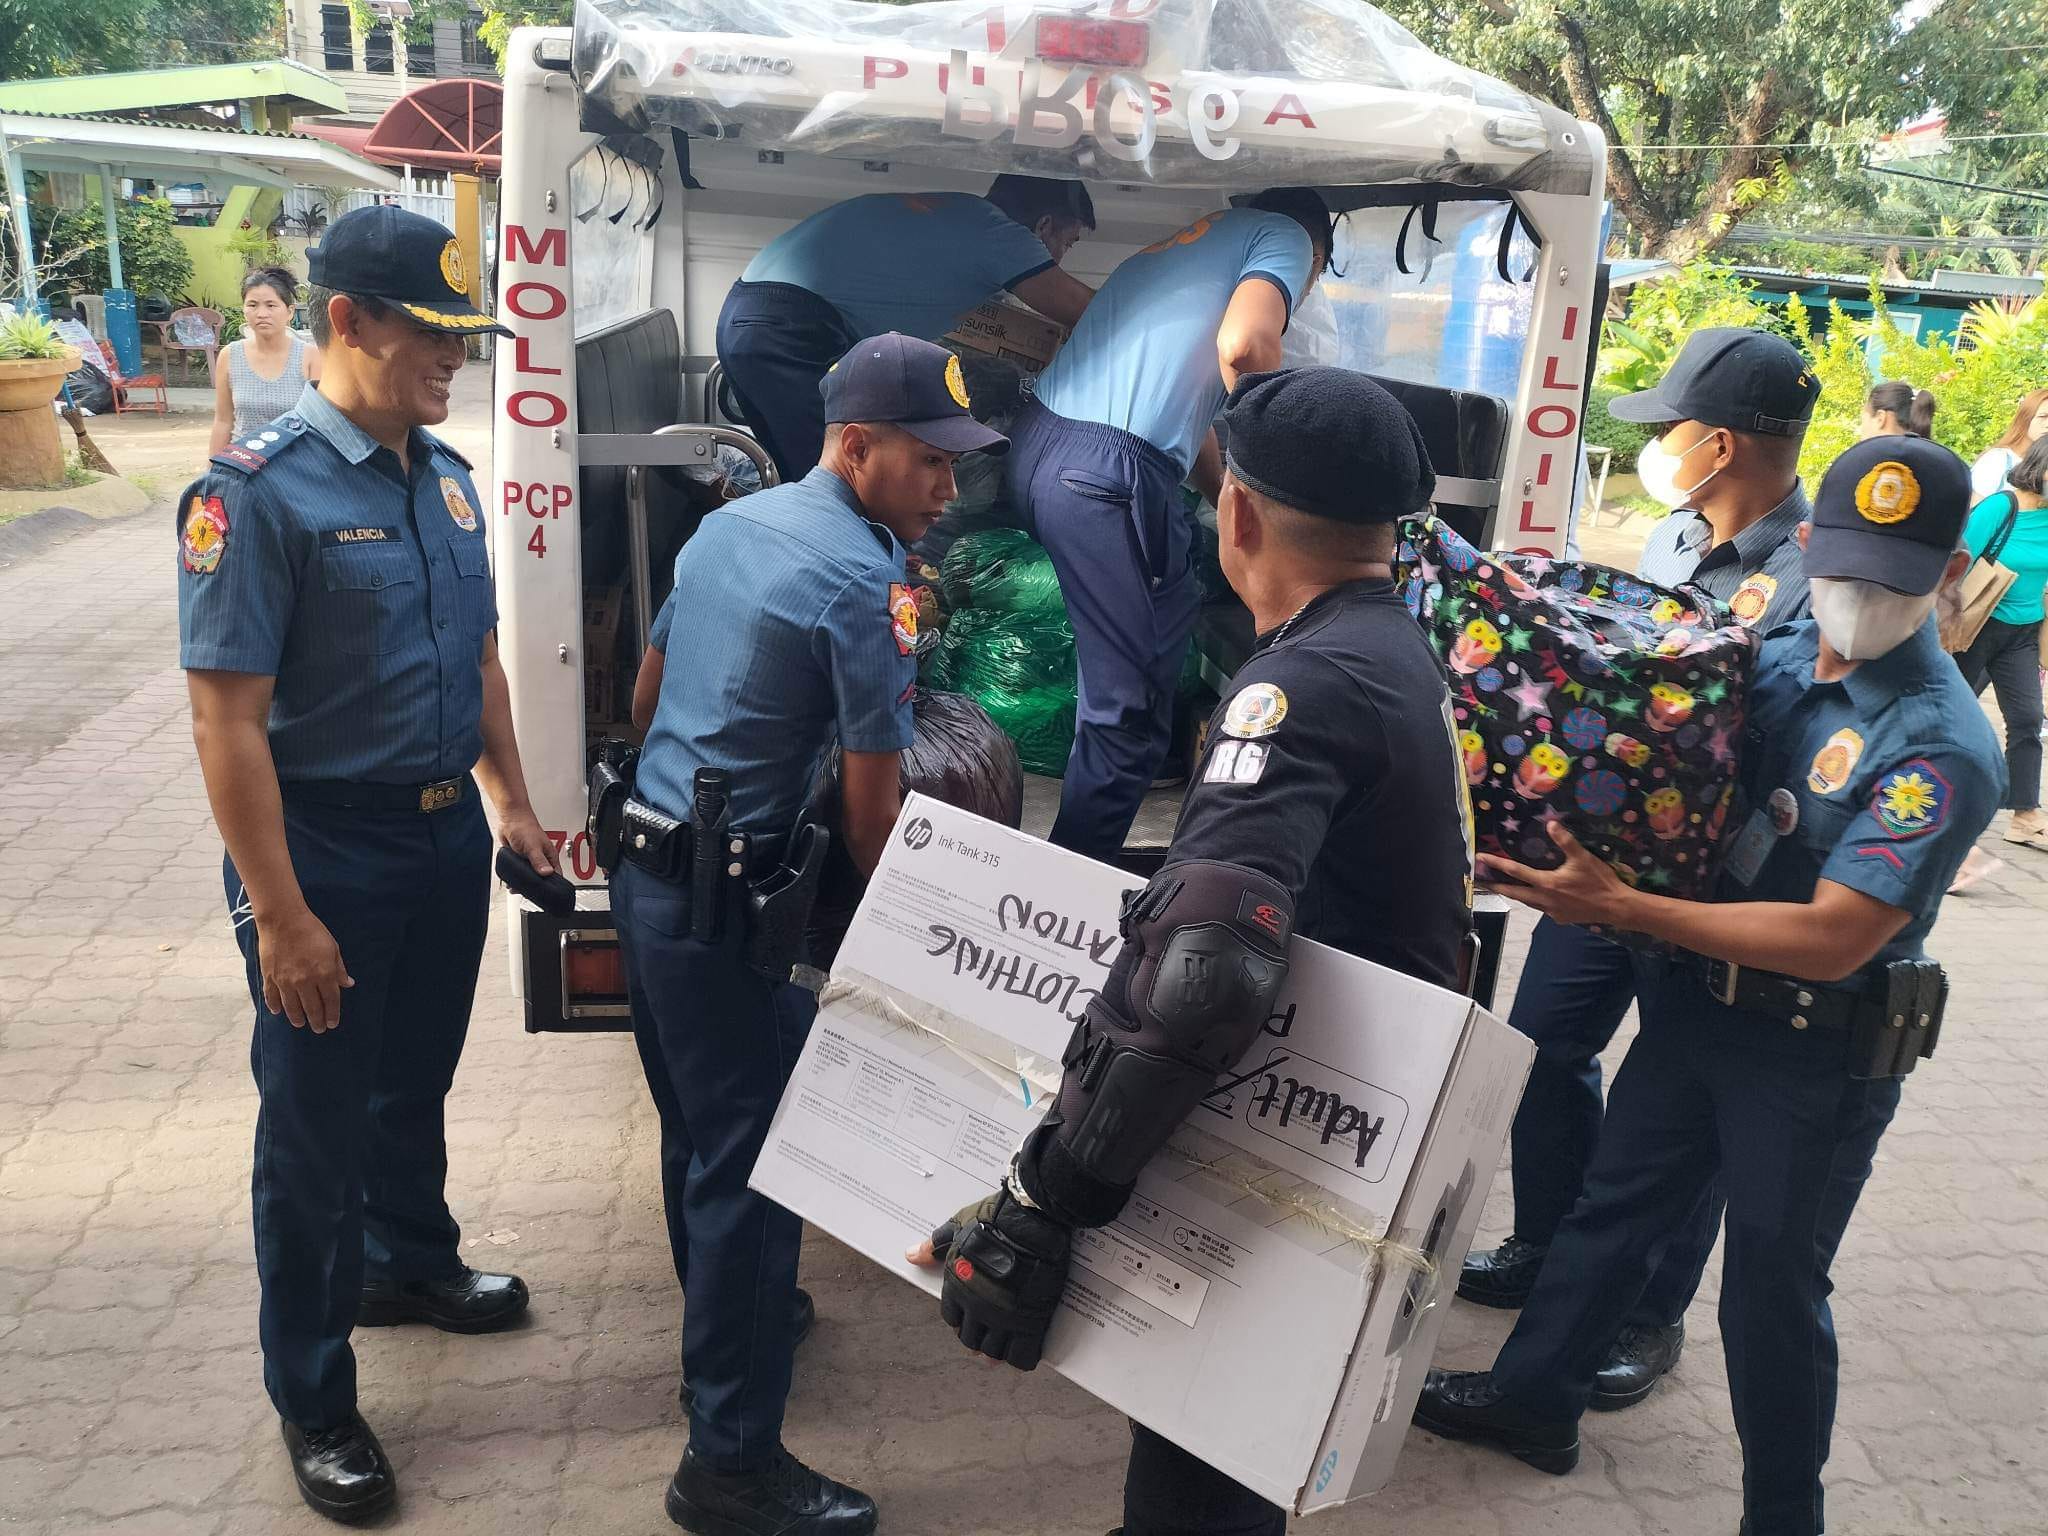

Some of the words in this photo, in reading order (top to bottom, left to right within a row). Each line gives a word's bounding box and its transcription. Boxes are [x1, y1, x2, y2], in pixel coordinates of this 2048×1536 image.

[505, 224, 567, 428] MOLO
[1512, 306, 1579, 559] ILOIL
[503, 481, 573, 520] PCP
[335, 528, 387, 543] VALENCIA
[527, 524, 547, 559] 4
[904, 817, 933, 850] hp
[938, 834, 956, 851] Ink
[957, 840, 981, 861] Tank
[981, 850, 1001, 869] 315
[998, 893, 1118, 969] ATION
